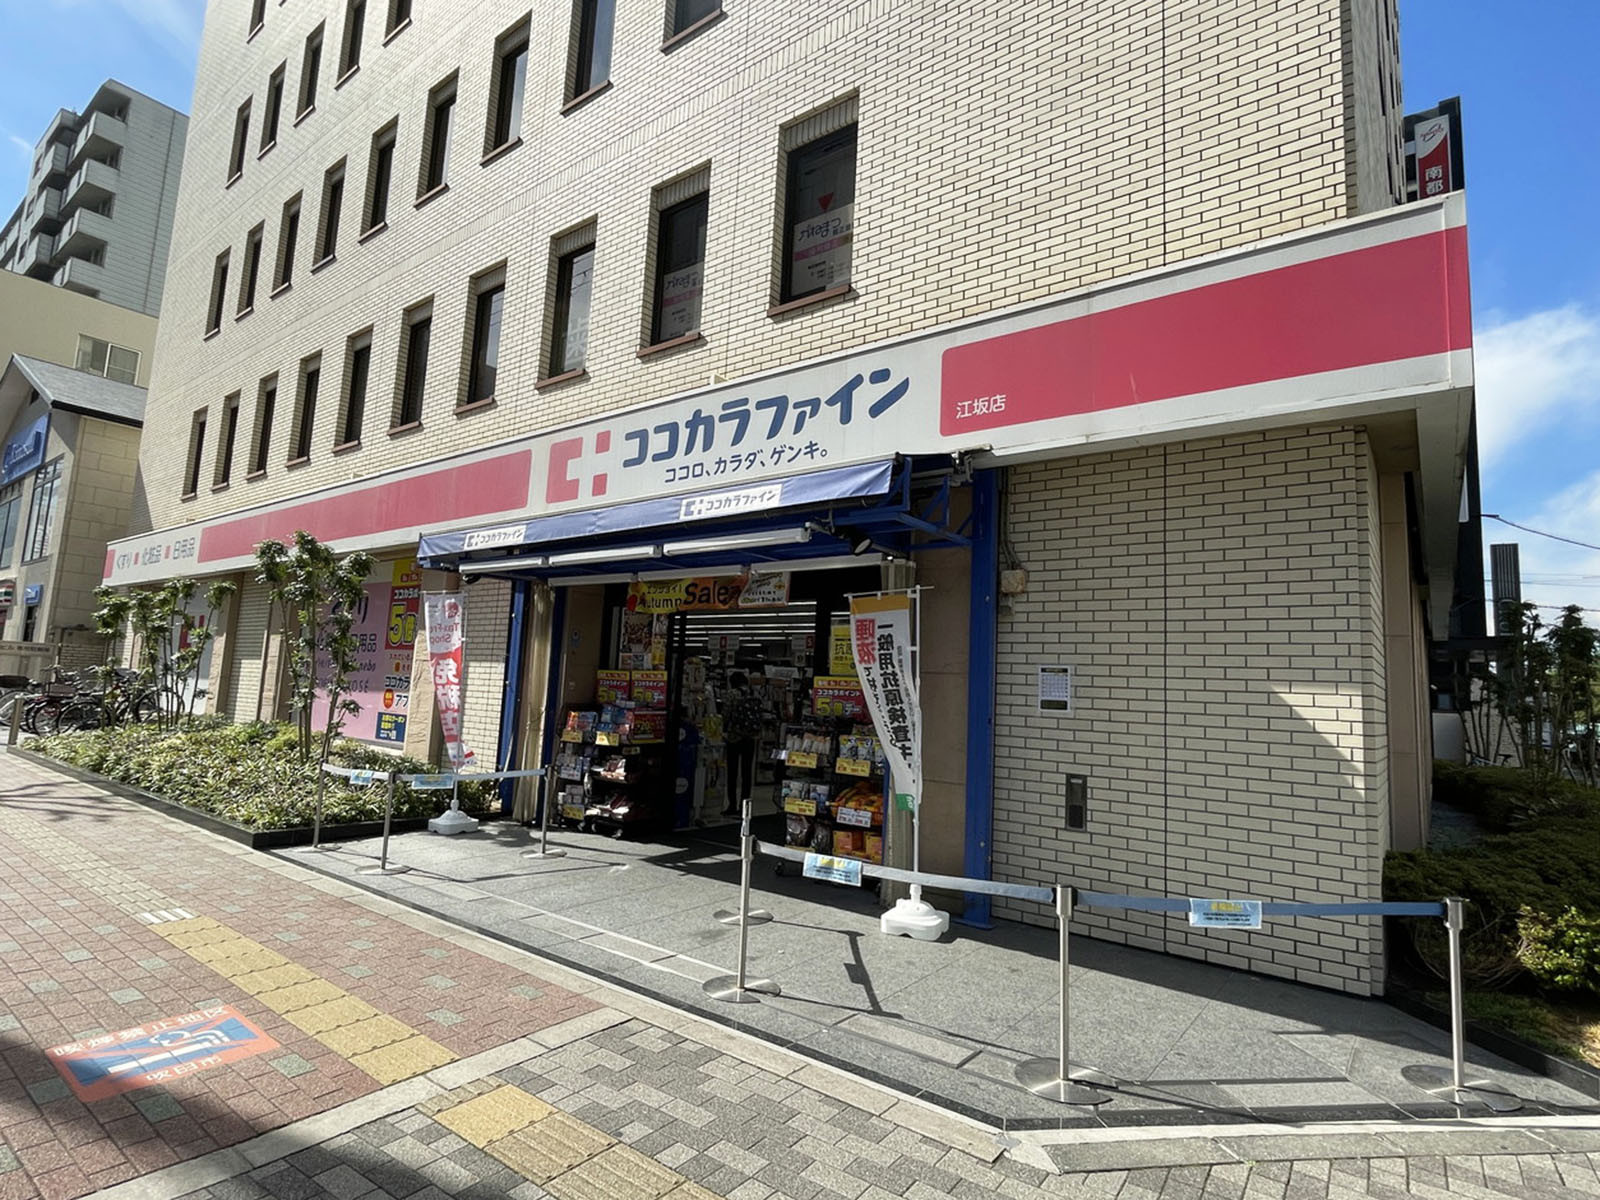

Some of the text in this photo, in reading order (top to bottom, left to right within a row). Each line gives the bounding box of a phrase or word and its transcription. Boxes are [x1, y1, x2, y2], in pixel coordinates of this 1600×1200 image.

[622, 367, 910, 468] ココカラファイン
[956, 394, 1006, 419] 江坂店
[664, 440, 829, 483] ココロ、カラダ、ゲンキ。
[705, 490, 776, 512] ココカラファイン
[480, 529, 523, 544] ココカラファイン
[684, 581, 731, 605] Sale
[54, 1005, 230, 1056] 喫煙禁止地区
[146, 1055, 223, 1081] 吹田市
